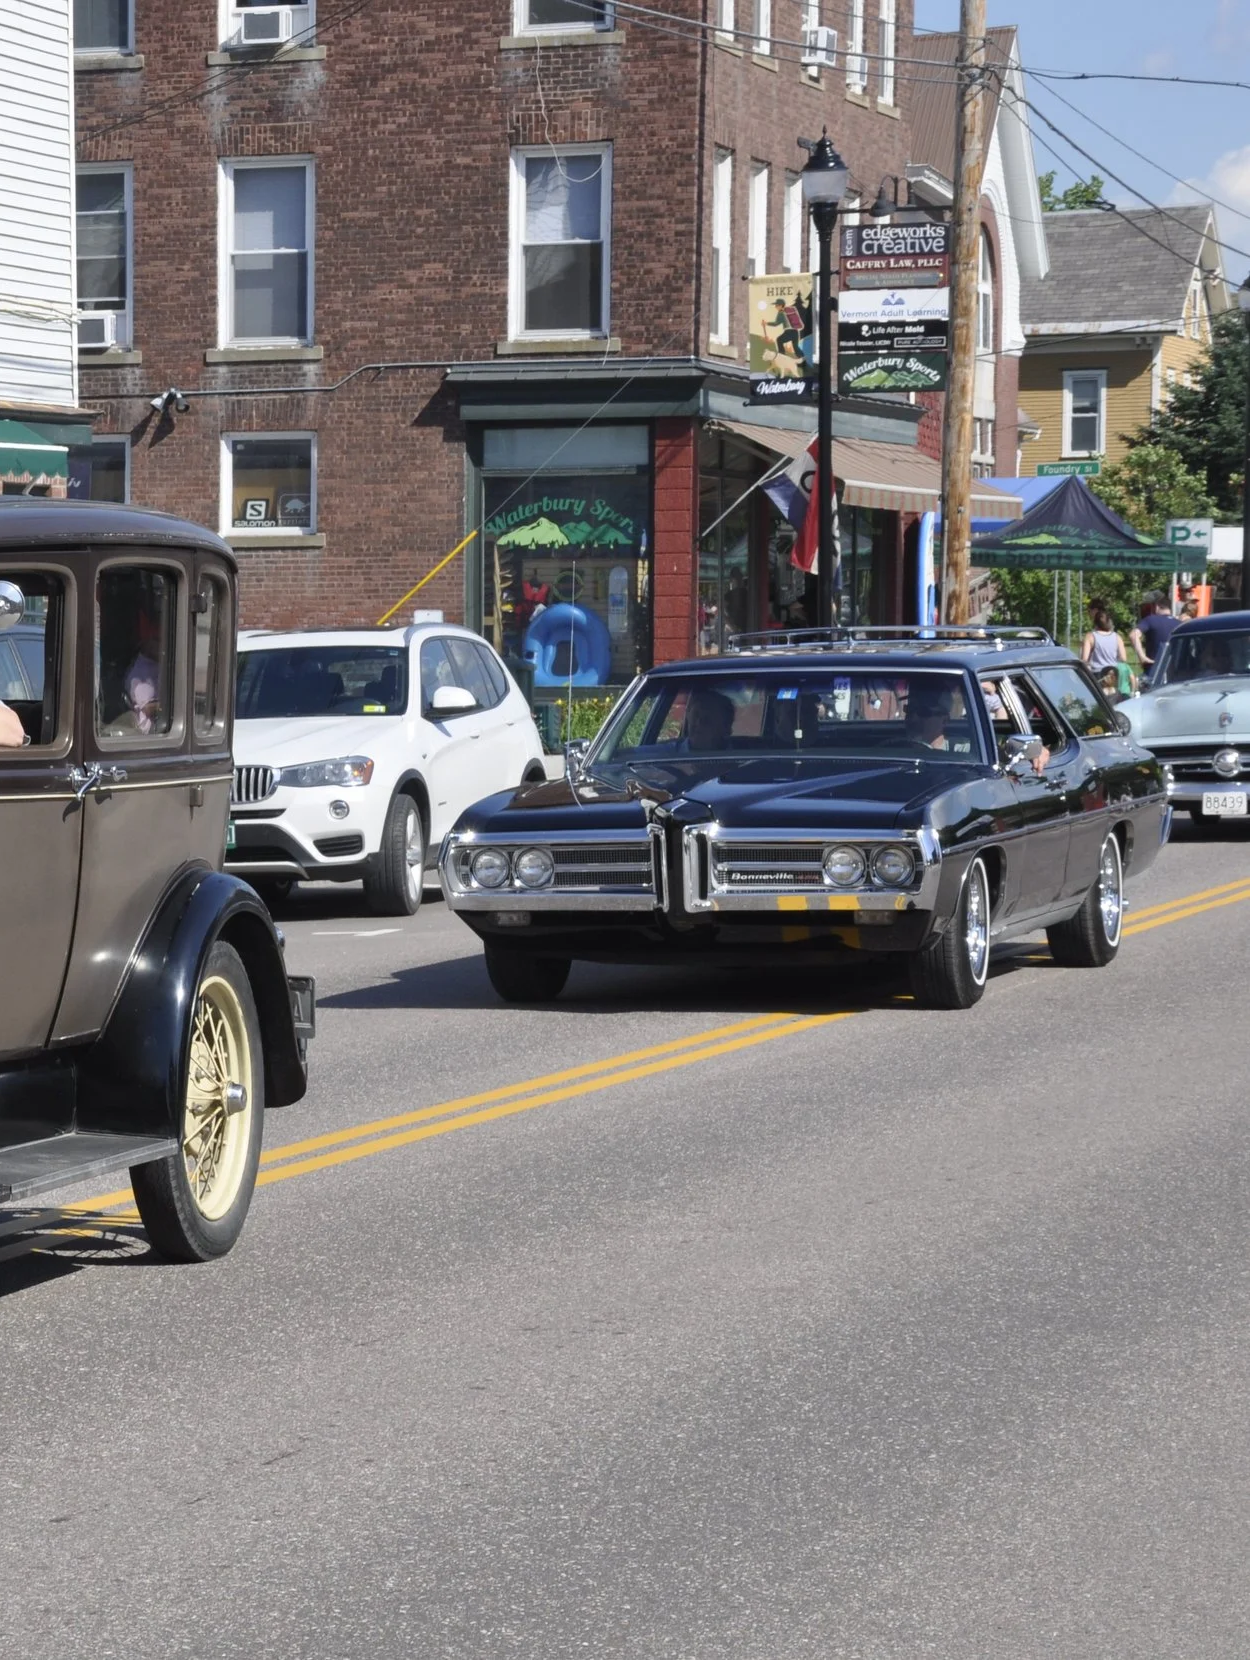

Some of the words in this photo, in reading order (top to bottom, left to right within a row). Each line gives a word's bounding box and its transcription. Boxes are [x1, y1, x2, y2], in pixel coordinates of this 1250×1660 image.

[862, 224, 945, 244] edgeworks
[861, 238, 945, 254] creative
[846, 260, 887, 269] CAFFRY
[890, 258, 915, 268] LAW,
[918, 258, 943, 266] PLLC
[766, 287, 793, 296] HIKE
[841, 310, 878, 318] Vermont
[881, 309, 903, 317] Adult
[907, 308, 946, 318] Learning
[886, 326, 903, 334] After
[843, 357, 905, 382] Waterbury
[906, 357, 941, 382] Sports
[756, 379, 806, 394] Waterbury
[1043, 465, 1081, 474] Foundry
[484, 496, 587, 536] Waterbury
[1170, 526, 1191, 544] P
[1005, 550, 1073, 567] Sports
[1107, 552, 1165, 566] More
[1205, 796, 1244, 809] 88439
[731, 872, 795, 881] Bonneville
